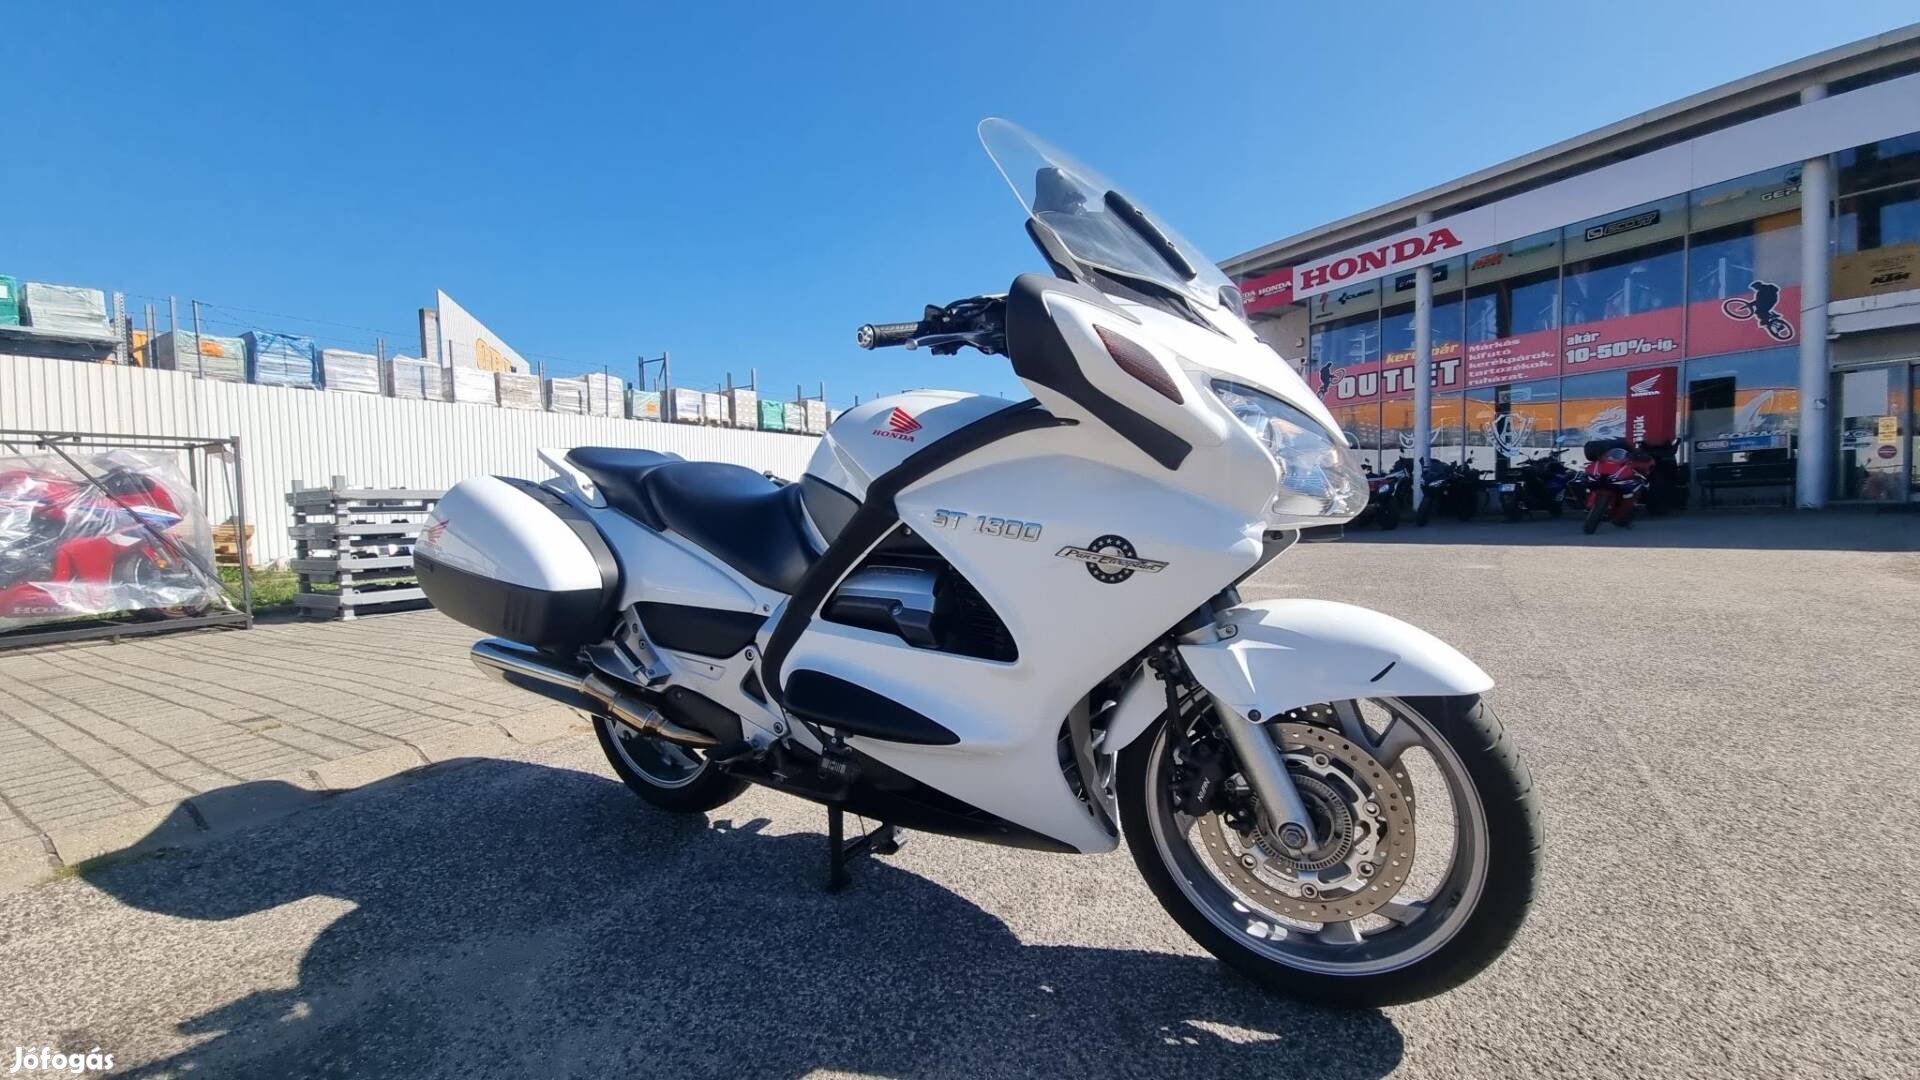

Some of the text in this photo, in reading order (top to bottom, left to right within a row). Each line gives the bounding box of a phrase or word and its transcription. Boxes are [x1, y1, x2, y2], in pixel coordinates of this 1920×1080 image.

[1300, 227, 1463, 291] HONDA
[1258, 281, 1292, 296] HONDA
[1469, 339, 1521, 352] Márkás
[1566, 331, 1600, 346] akár
[871, 429, 915, 442] HONDA
[932, 508, 1043, 543] ST 1300
